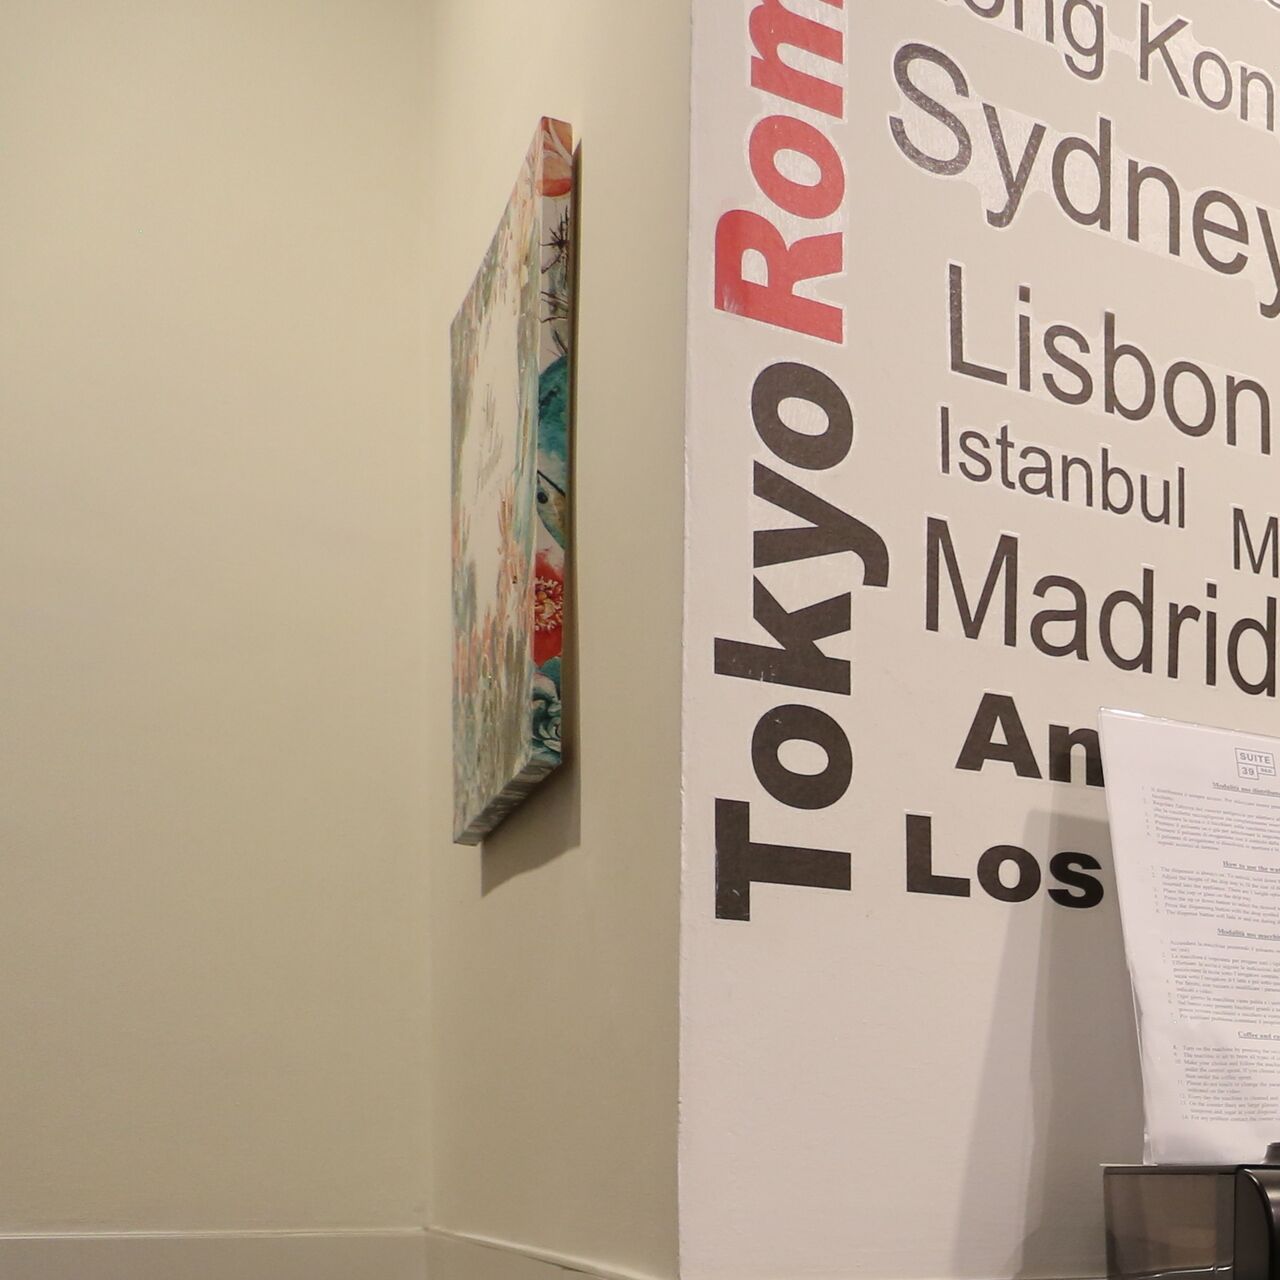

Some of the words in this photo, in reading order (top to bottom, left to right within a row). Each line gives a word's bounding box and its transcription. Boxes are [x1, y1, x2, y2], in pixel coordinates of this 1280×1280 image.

[714, 0, 844, 344] Rom
[948, 263, 1272, 456] Lisbon
[939, 405, 1186, 529] Istanbul
[713, 360, 890, 921] Tokyo
[925, 516, 1277, 698] Madrid
[1240, 752, 1271, 764] SUITE
[1241, 766, 1255, 776] 39
[905, 813, 1105, 909] Los
